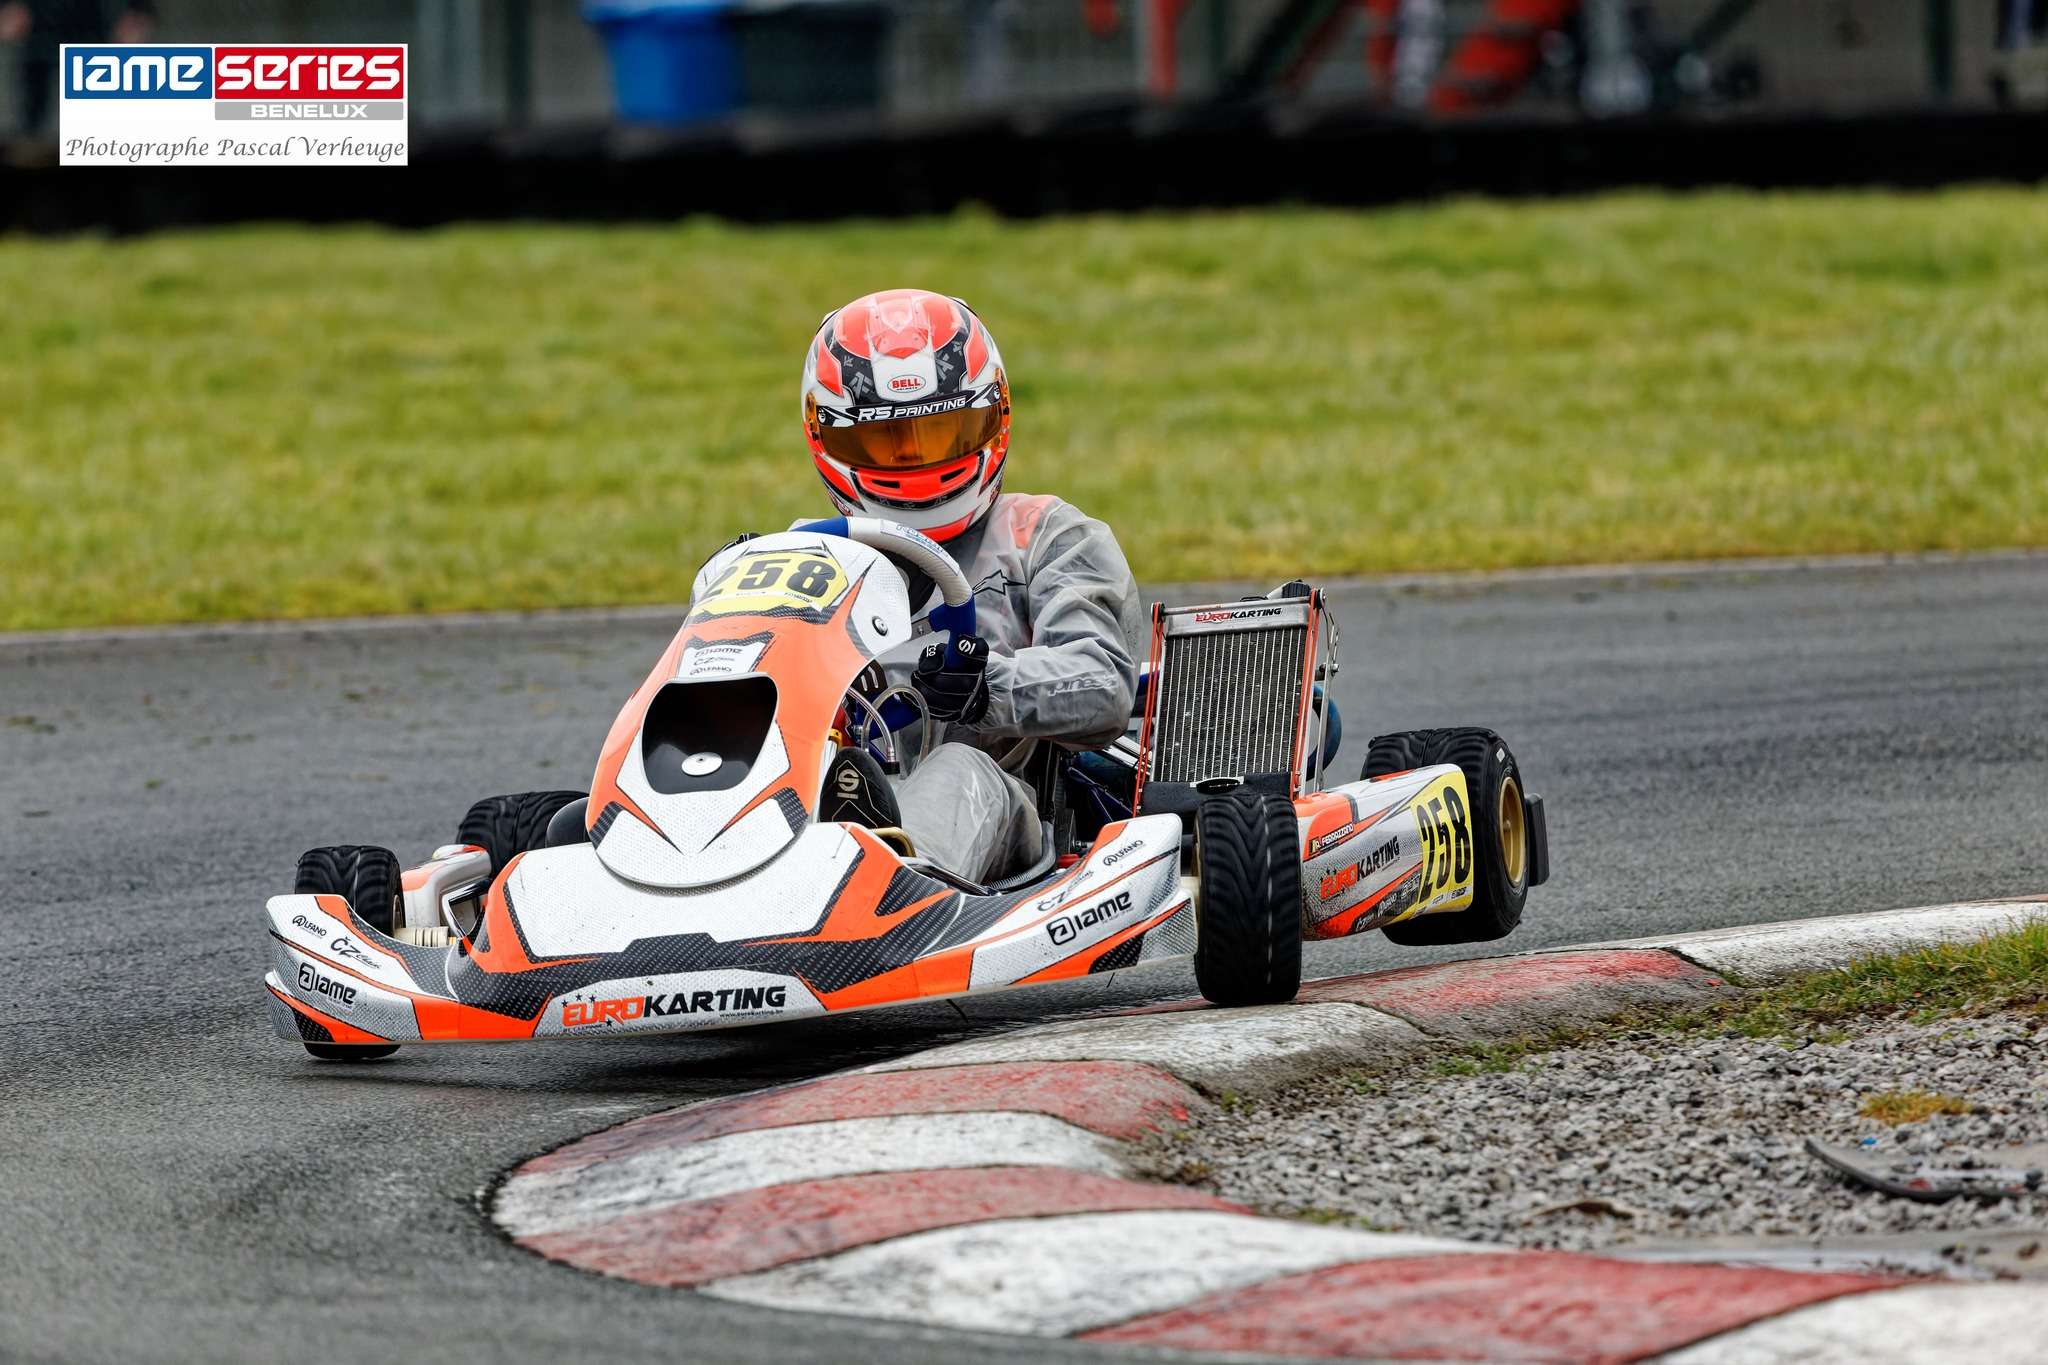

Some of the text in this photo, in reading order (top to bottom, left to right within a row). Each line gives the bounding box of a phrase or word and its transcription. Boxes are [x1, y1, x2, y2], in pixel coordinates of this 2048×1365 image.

[892, 378, 922, 389] BELL
[702, 558, 837, 598] 258
[1195, 607, 1282, 623] EUROKARTING
[1417, 786, 1472, 904] 258
[1320, 835, 1400, 900] EUROKARTING
[292, 915, 328, 937] ALFANO
[562, 985, 786, 1027] EUROKARTING
